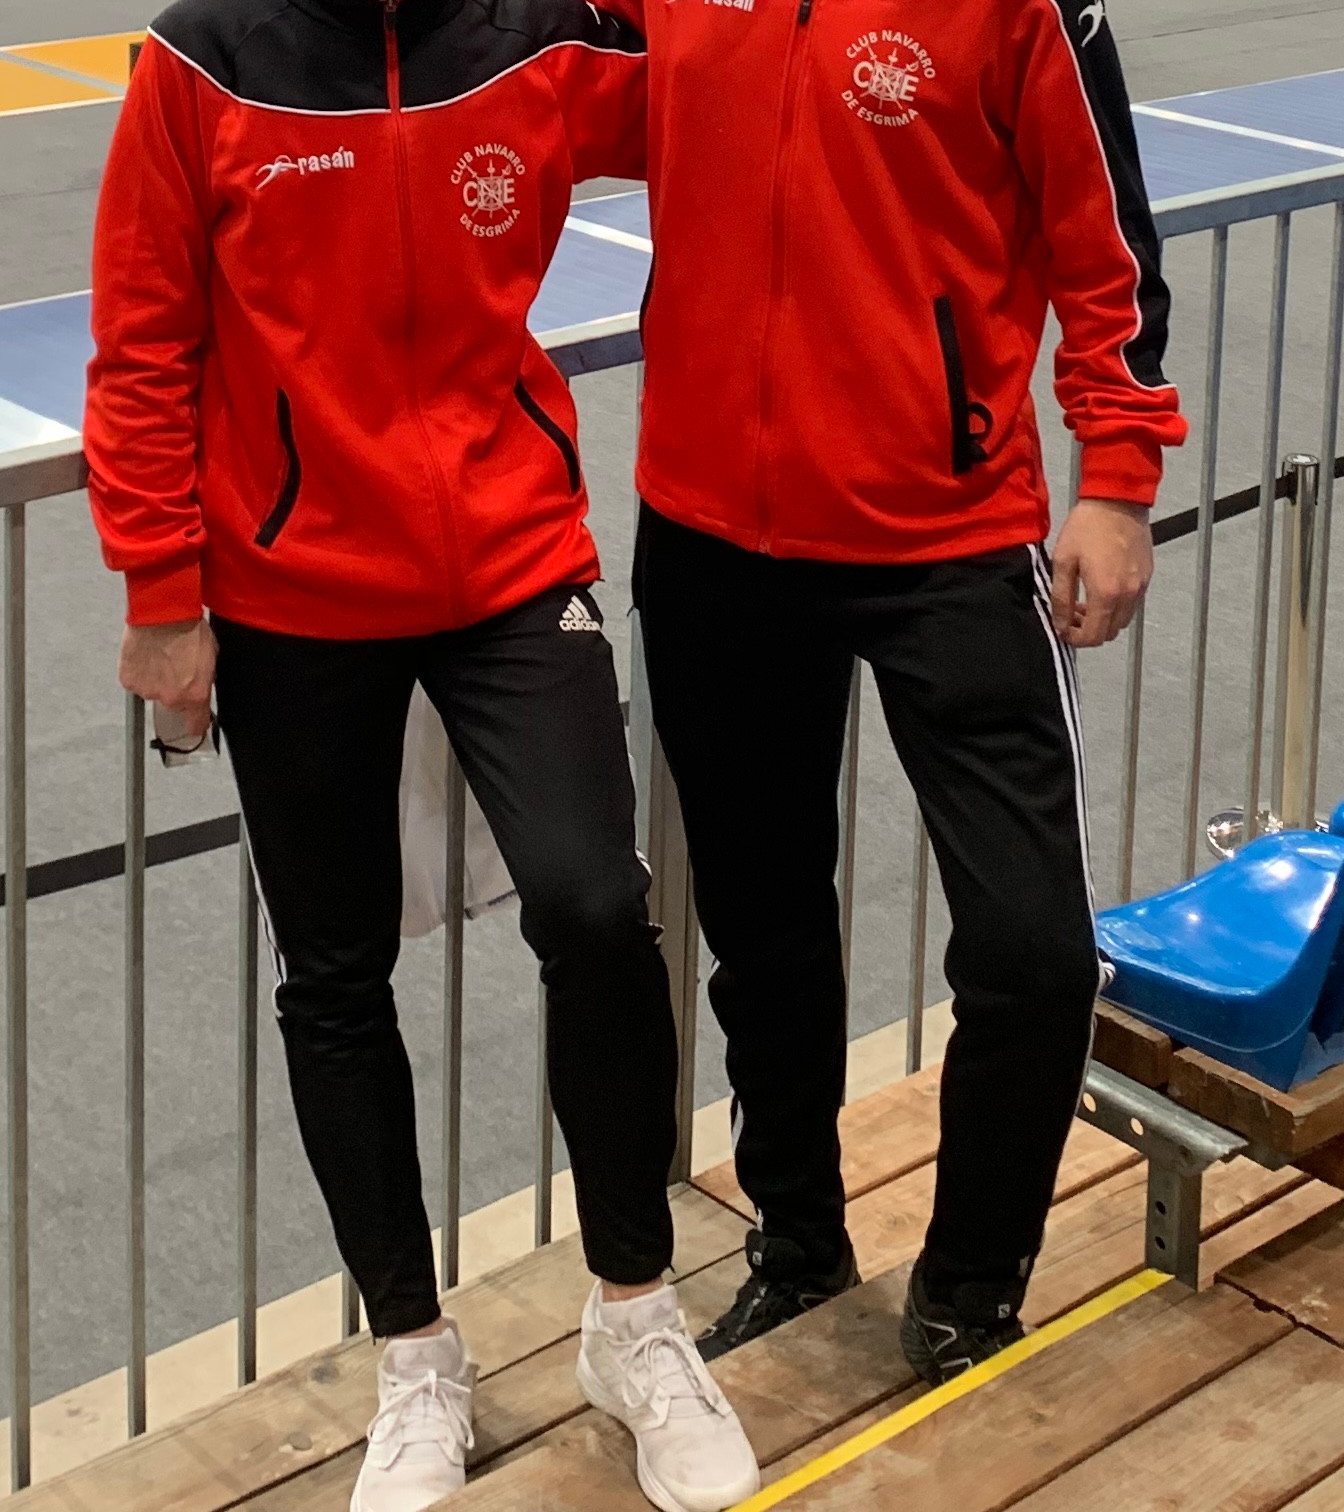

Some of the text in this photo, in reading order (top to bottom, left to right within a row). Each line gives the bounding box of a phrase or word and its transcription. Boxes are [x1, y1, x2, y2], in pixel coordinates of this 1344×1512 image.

[846, 29, 936, 79] CLUB NAVARRO
[841, 89, 919, 126] DE ESGRIMA
[450, 142, 526, 185] CLUB NAVARRO
[459, 208, 521, 238] DE ESGRIMA
[558, 619, 602, 632] adidas
